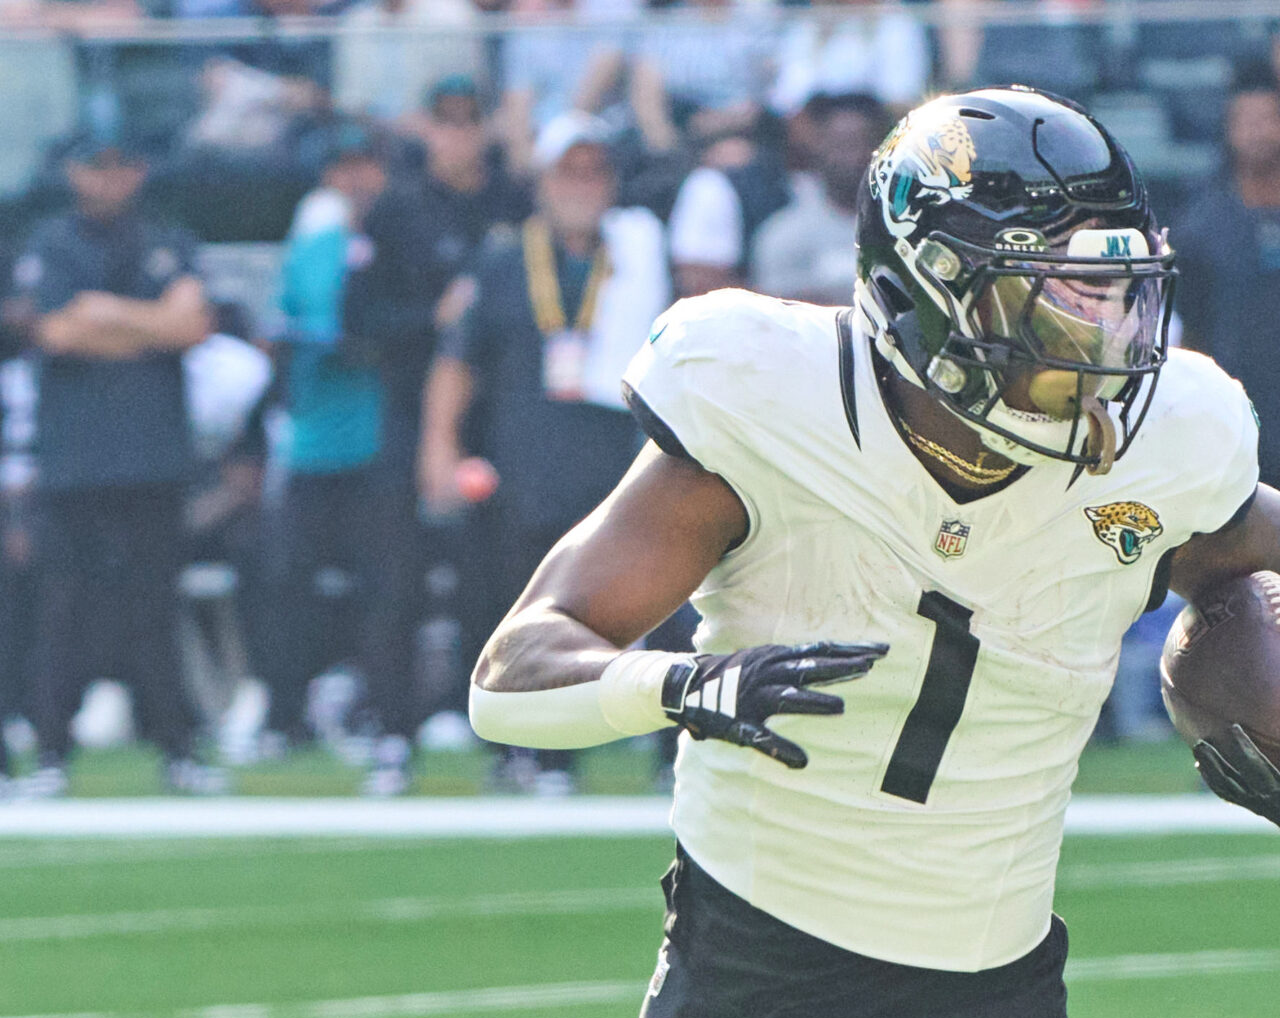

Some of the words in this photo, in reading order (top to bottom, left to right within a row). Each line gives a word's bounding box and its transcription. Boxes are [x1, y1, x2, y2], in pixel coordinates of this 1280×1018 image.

[995, 242, 1045, 253] OAKLEY
[1100, 235, 1131, 258] JAX
[937, 533, 962, 553] NFL
[880, 589, 980, 805] 1
